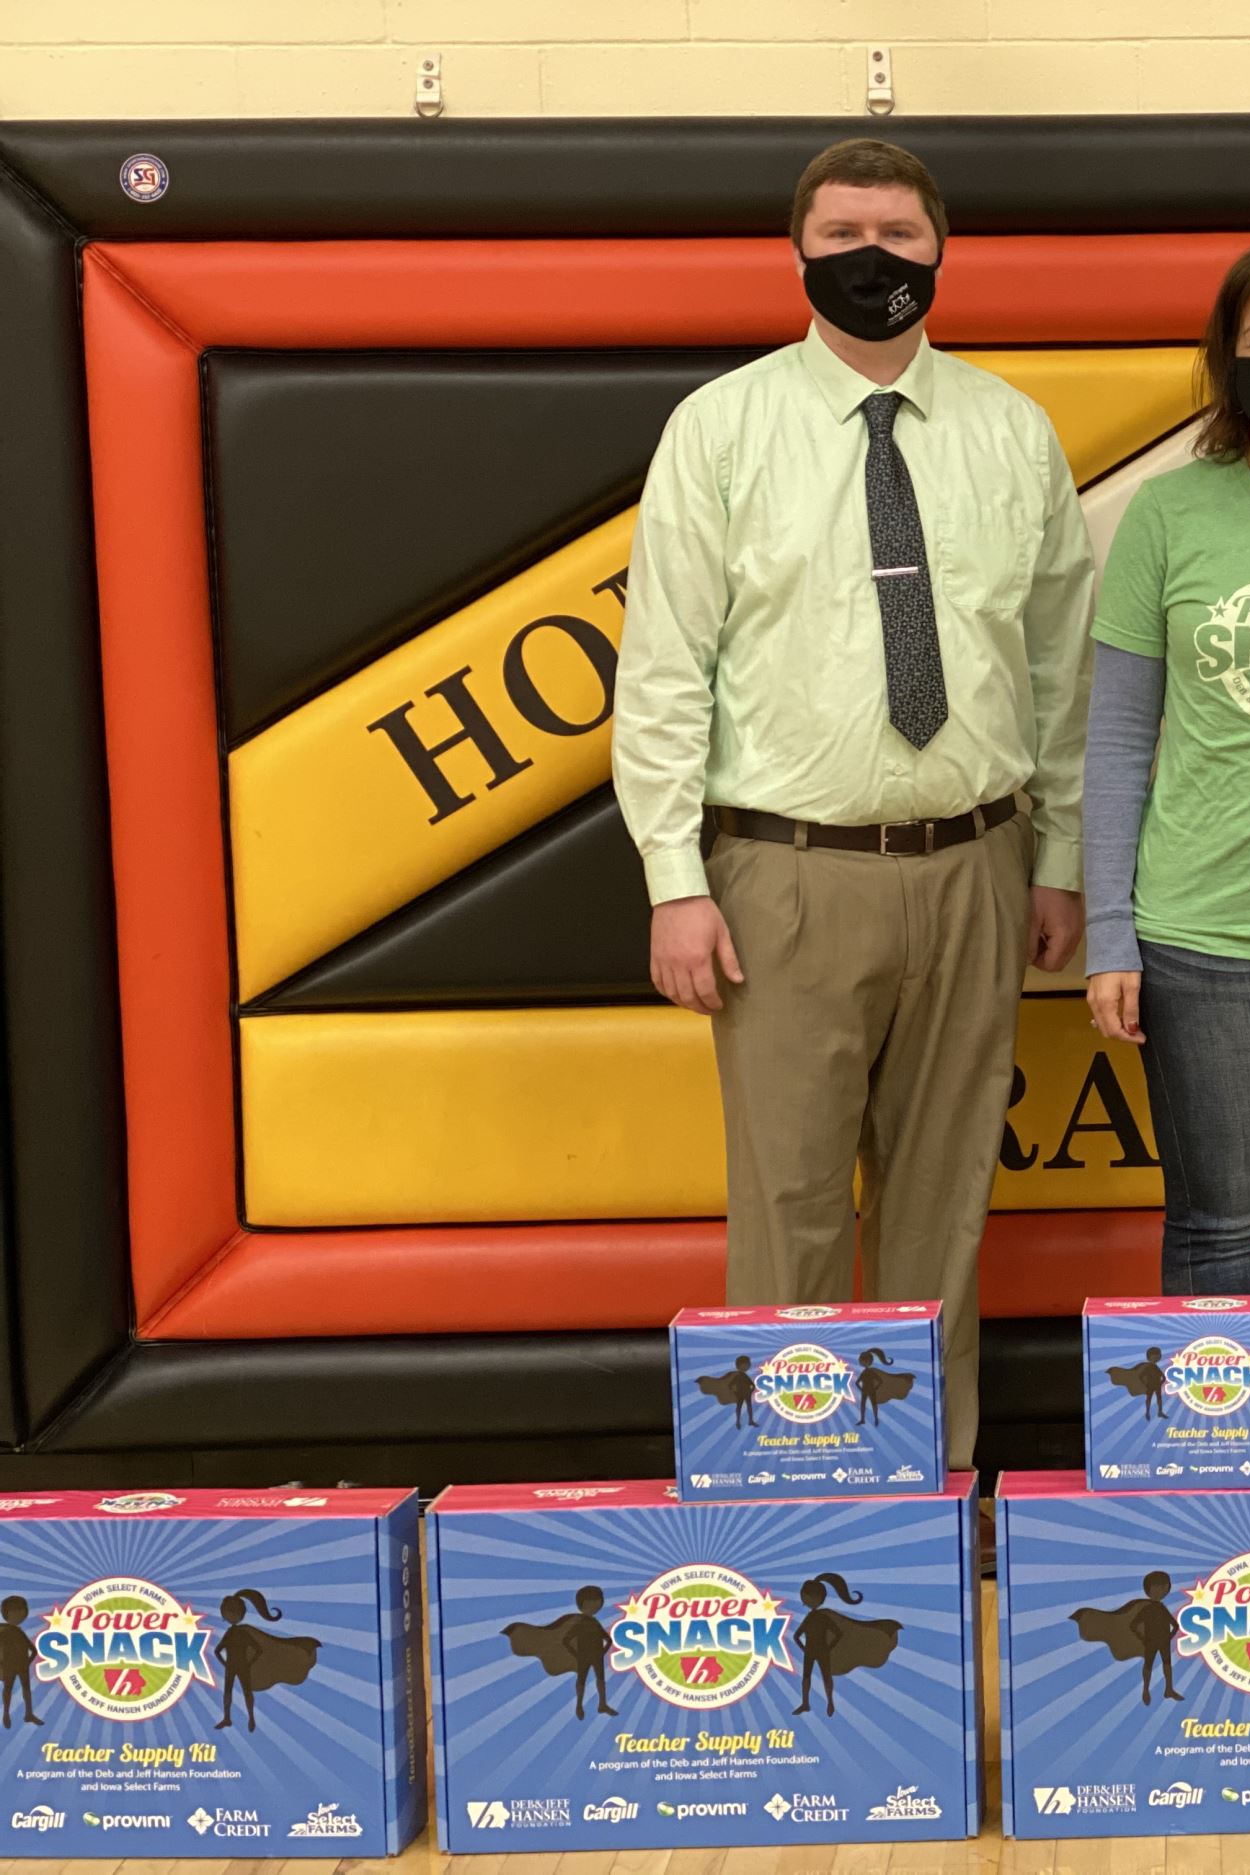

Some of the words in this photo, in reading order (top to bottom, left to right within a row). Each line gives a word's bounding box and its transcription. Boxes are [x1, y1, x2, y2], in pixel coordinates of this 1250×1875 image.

[1232, 676, 1248, 696] DEB
[366, 565, 628, 826] HO
[772, 1360, 836, 1373] Power
[1183, 1352, 1245, 1366] Power
[755, 1373, 855, 1401] SNACK
[759, 1435, 801, 1446] Teacher
[804, 1434, 841, 1447] Supply
[843, 1433, 859, 1443] Kit
[1167, 1427, 1209, 1438] Teacher
[1212, 1427, 1248, 1440] Supply
[847, 1476, 881, 1484] CREDIT
[1227, 1562, 1249, 1576] IOWA
[661, 1576, 682, 1591] IOWA
[684, 1571, 715, 1579] SELECT
[717, 1573, 746, 1592] FARMS
[84, 1589, 105, 1603] IOWA
[106, 1584, 136, 1592] SELECT
[139, 1587, 167, 1606] FARMS
[643, 1592, 758, 1618] Power
[67, 1605, 179, 1631] Power
[612, 1618, 791, 1670] SNACK
[37, 1631, 212, 1682] SNACK
[615, 1732, 690, 1752] Teacher
[696, 1730, 762, 1755] Supply
[766, 1728, 795, 1748] Kit
[42, 1743, 114, 1763] Teacher
[120, 1743, 185, 1768] Supply
[189, 1742, 217, 1762] Kit
[793, 1794, 835, 1806] FARM
[886, 1796, 935, 1808] Select
[1078, 1795, 1135, 1806] HANSEN
[1149, 1788, 1203, 1809] Cargill
[216, 1808, 257, 1821] FARM
[307, 1813, 356, 1825] Select
[512, 1810, 570, 1821] HANSEN
[584, 1802, 638, 1823] Cargill
[678, 1803, 746, 1820] provimi
[791, 1809, 849, 1822] CREDIT
[886, 1807, 936, 1816] FARMS
[12, 1811, 65, 1832] Cargill
[103, 1815, 170, 1831] provimi
[307, 1825, 356, 1833] FARMS
[214, 1823, 271, 1836] CREDIT
